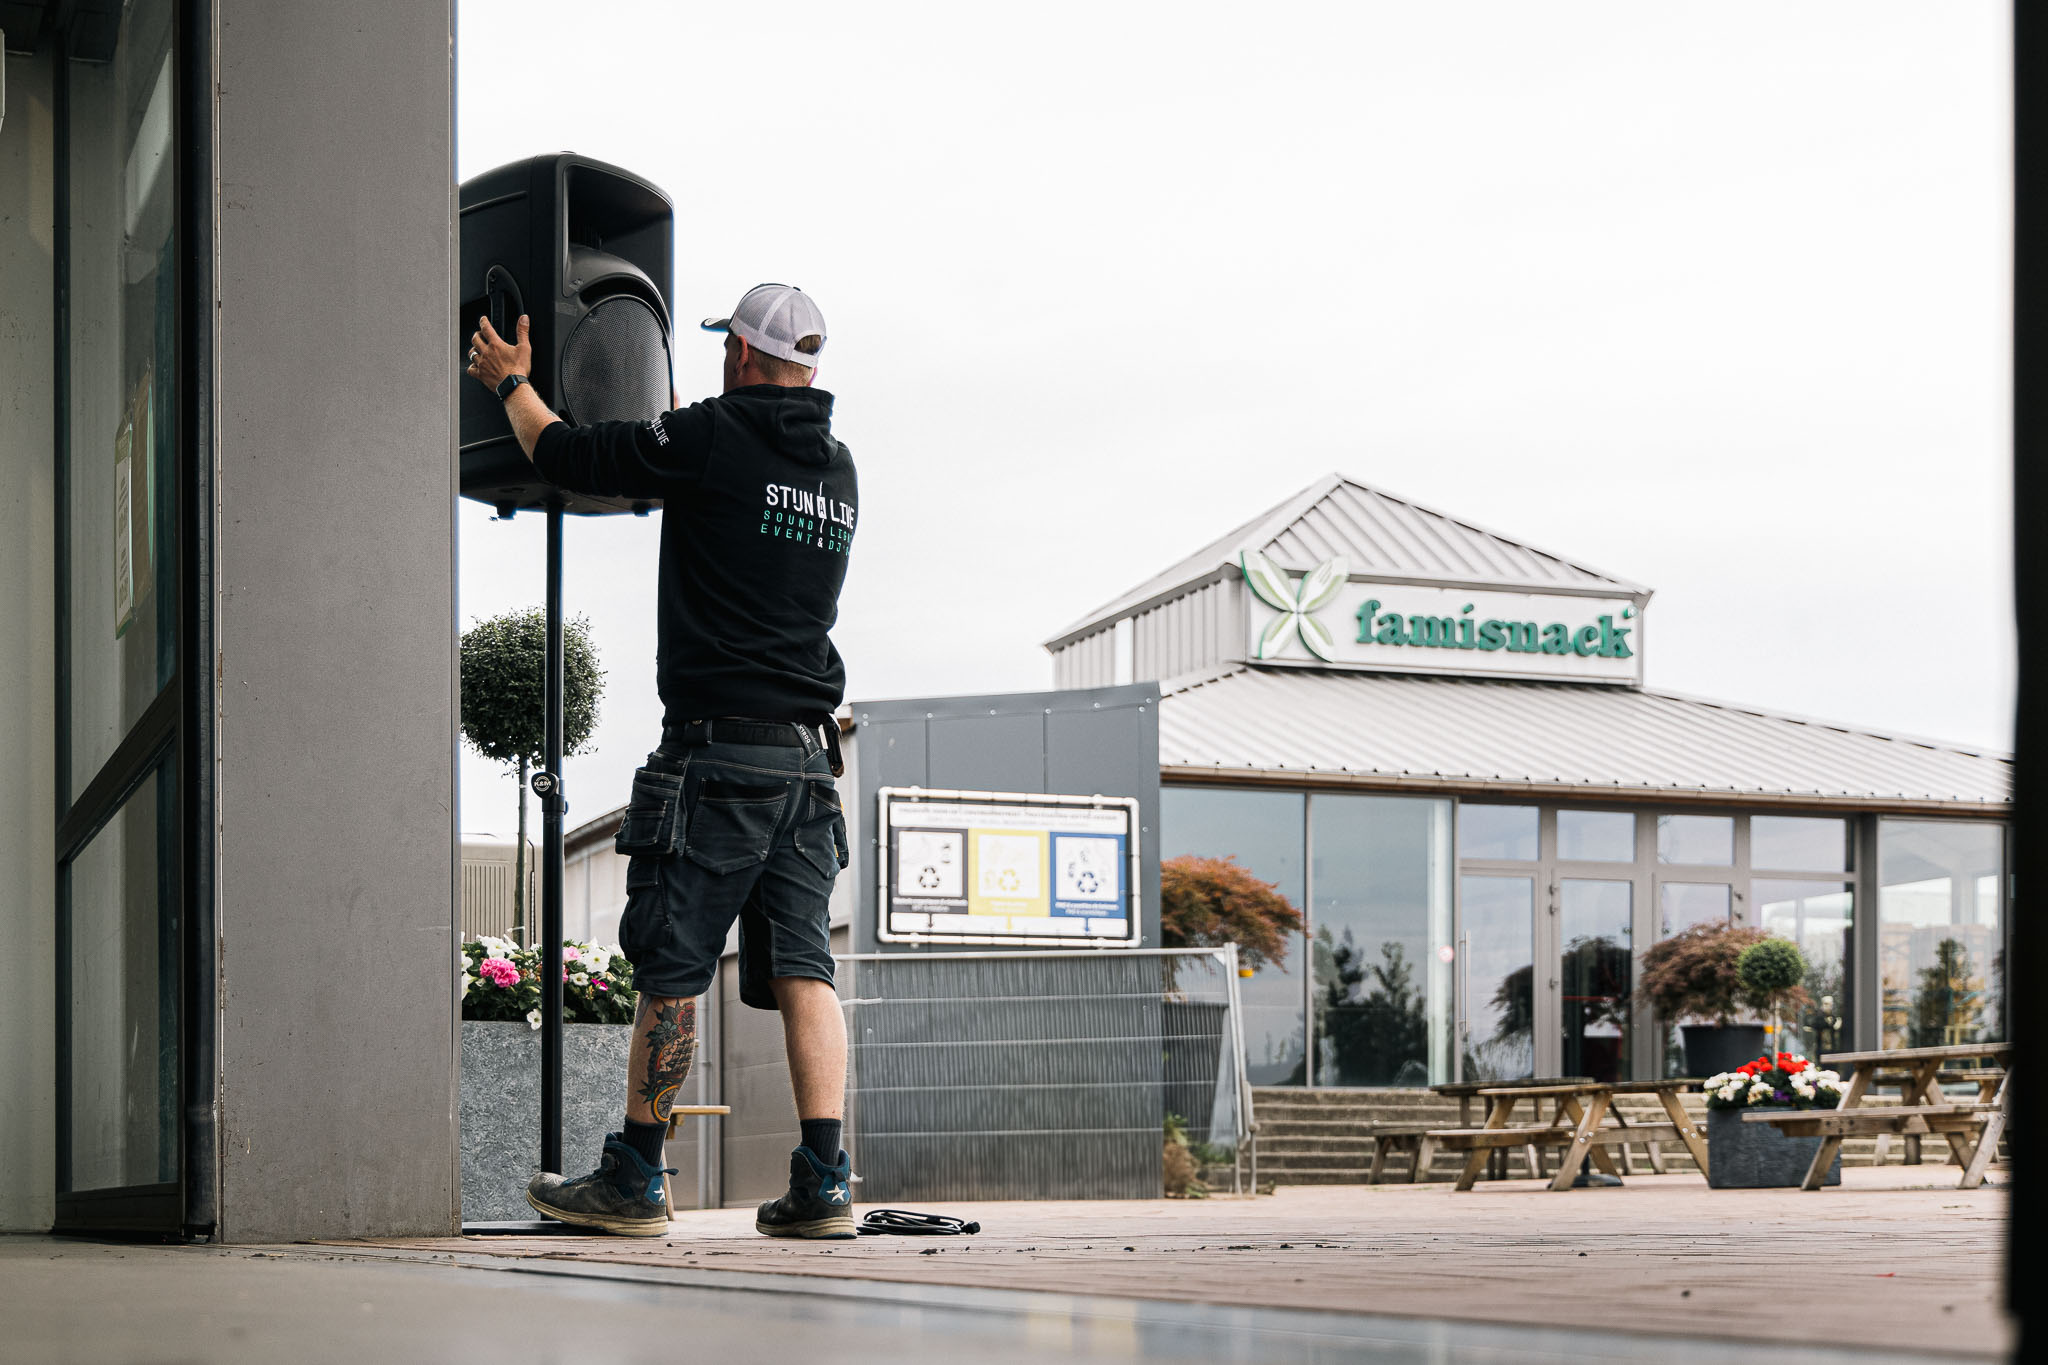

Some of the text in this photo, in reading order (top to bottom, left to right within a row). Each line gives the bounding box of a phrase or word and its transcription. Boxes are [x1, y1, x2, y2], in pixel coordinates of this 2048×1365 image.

[654, 424, 670, 446] LIVE
[766, 484, 855, 529] STIJN LIVE
[764, 510, 813, 530] SOUND
[761, 523, 813, 544] EVENT
[817, 537, 823, 548] &
[1356, 600, 1633, 658] famisnack
